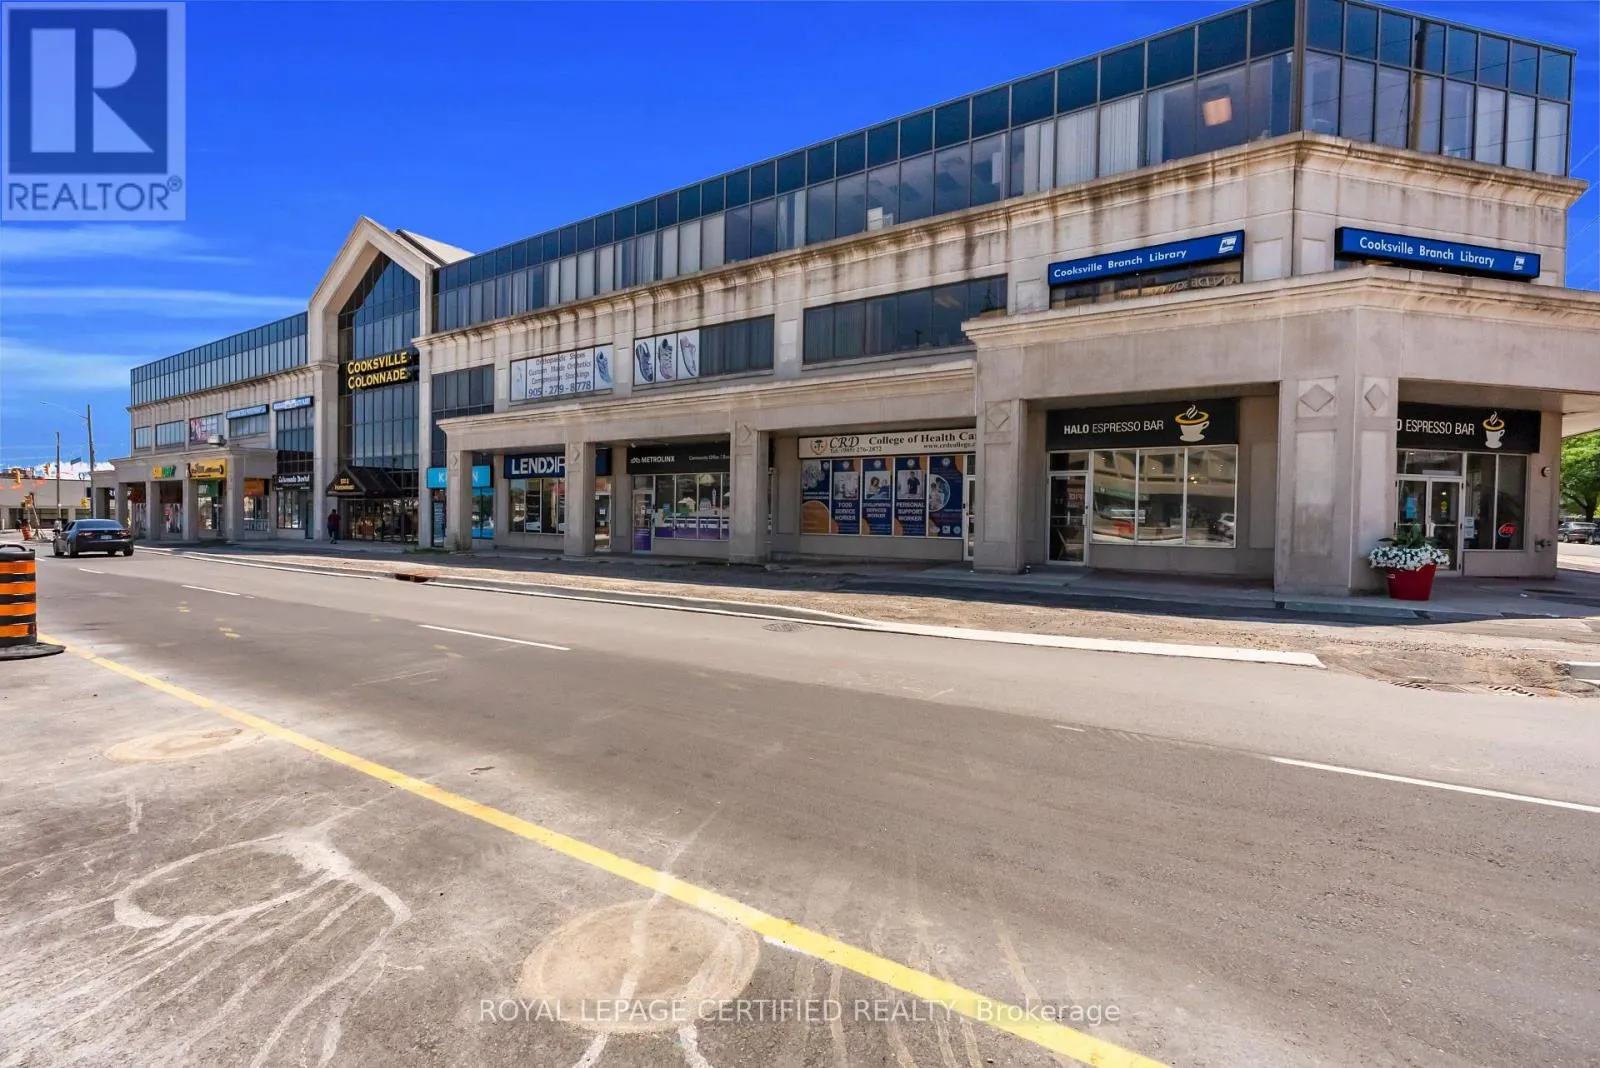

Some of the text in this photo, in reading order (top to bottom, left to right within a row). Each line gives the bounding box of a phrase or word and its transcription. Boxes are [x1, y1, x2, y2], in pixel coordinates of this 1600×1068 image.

[1359, 236, 1495, 268] Cooksville Branch Library
[1053, 249, 1187, 278] Cooksville Branch Library
[567, 360, 592, 370] Orhotics
[1063, 420, 1164, 435] HALO ESPRESSO BAR
[1405, 419, 1453, 434] ESPRESSO
[1454, 422, 1475, 436] BAR
[829, 436, 860, 449] CRD
[868, 436, 905, 445] College
[907, 434, 919, 443] of
[921, 433, 956, 443] Health
[641, 455, 675, 463] METROLINX
